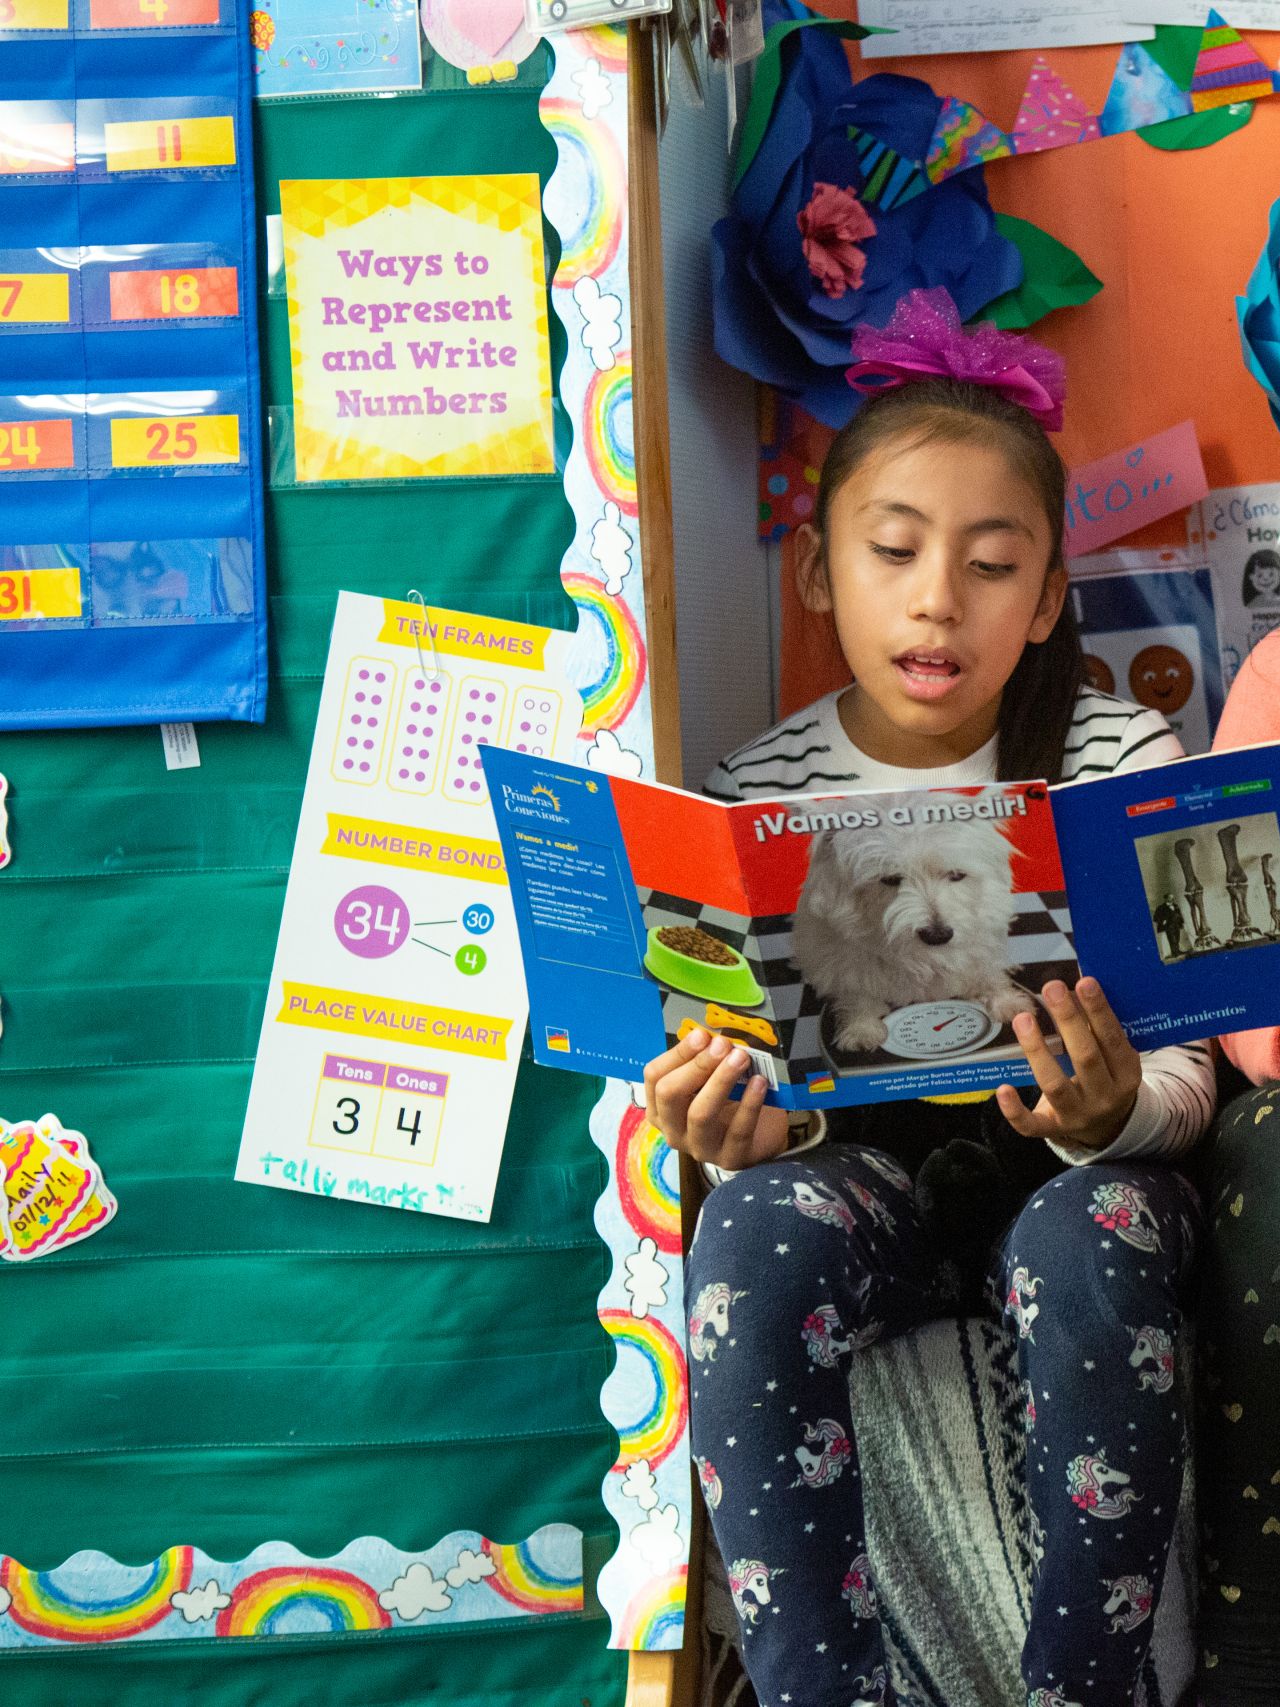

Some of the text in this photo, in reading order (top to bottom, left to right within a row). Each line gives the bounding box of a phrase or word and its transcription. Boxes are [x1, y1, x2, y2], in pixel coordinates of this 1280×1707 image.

[157, 125, 181, 162] 11
[337, 249, 489, 284] Ways to
[161, 275, 200, 313] 18
[321, 295, 512, 333] Represent
[321, 341, 517, 372] and Write
[335, 387, 508, 419] Numbers
[147, 423, 198, 460] 25
[396, 617, 534, 655] TEN FRAMES
[502, 785, 553, 808] Primeras
[505, 798, 570, 824] Conexiones
[754, 794, 1026, 843] ¡Vamos a medir!
[336, 828, 431, 859] NUMBER
[344, 901, 400, 945] 34
[467, 911, 490, 929] 30
[465, 952, 477, 969] 4
[289, 996, 502, 1046] PLACE VALUE CHART
[1124, 1005, 1247, 1038] Descubrimientos
[337, 1062, 437, 1092] Tens Ones
[332, 1097, 421, 1145] 3 4
[259, 1152, 428, 1212] tally marks
